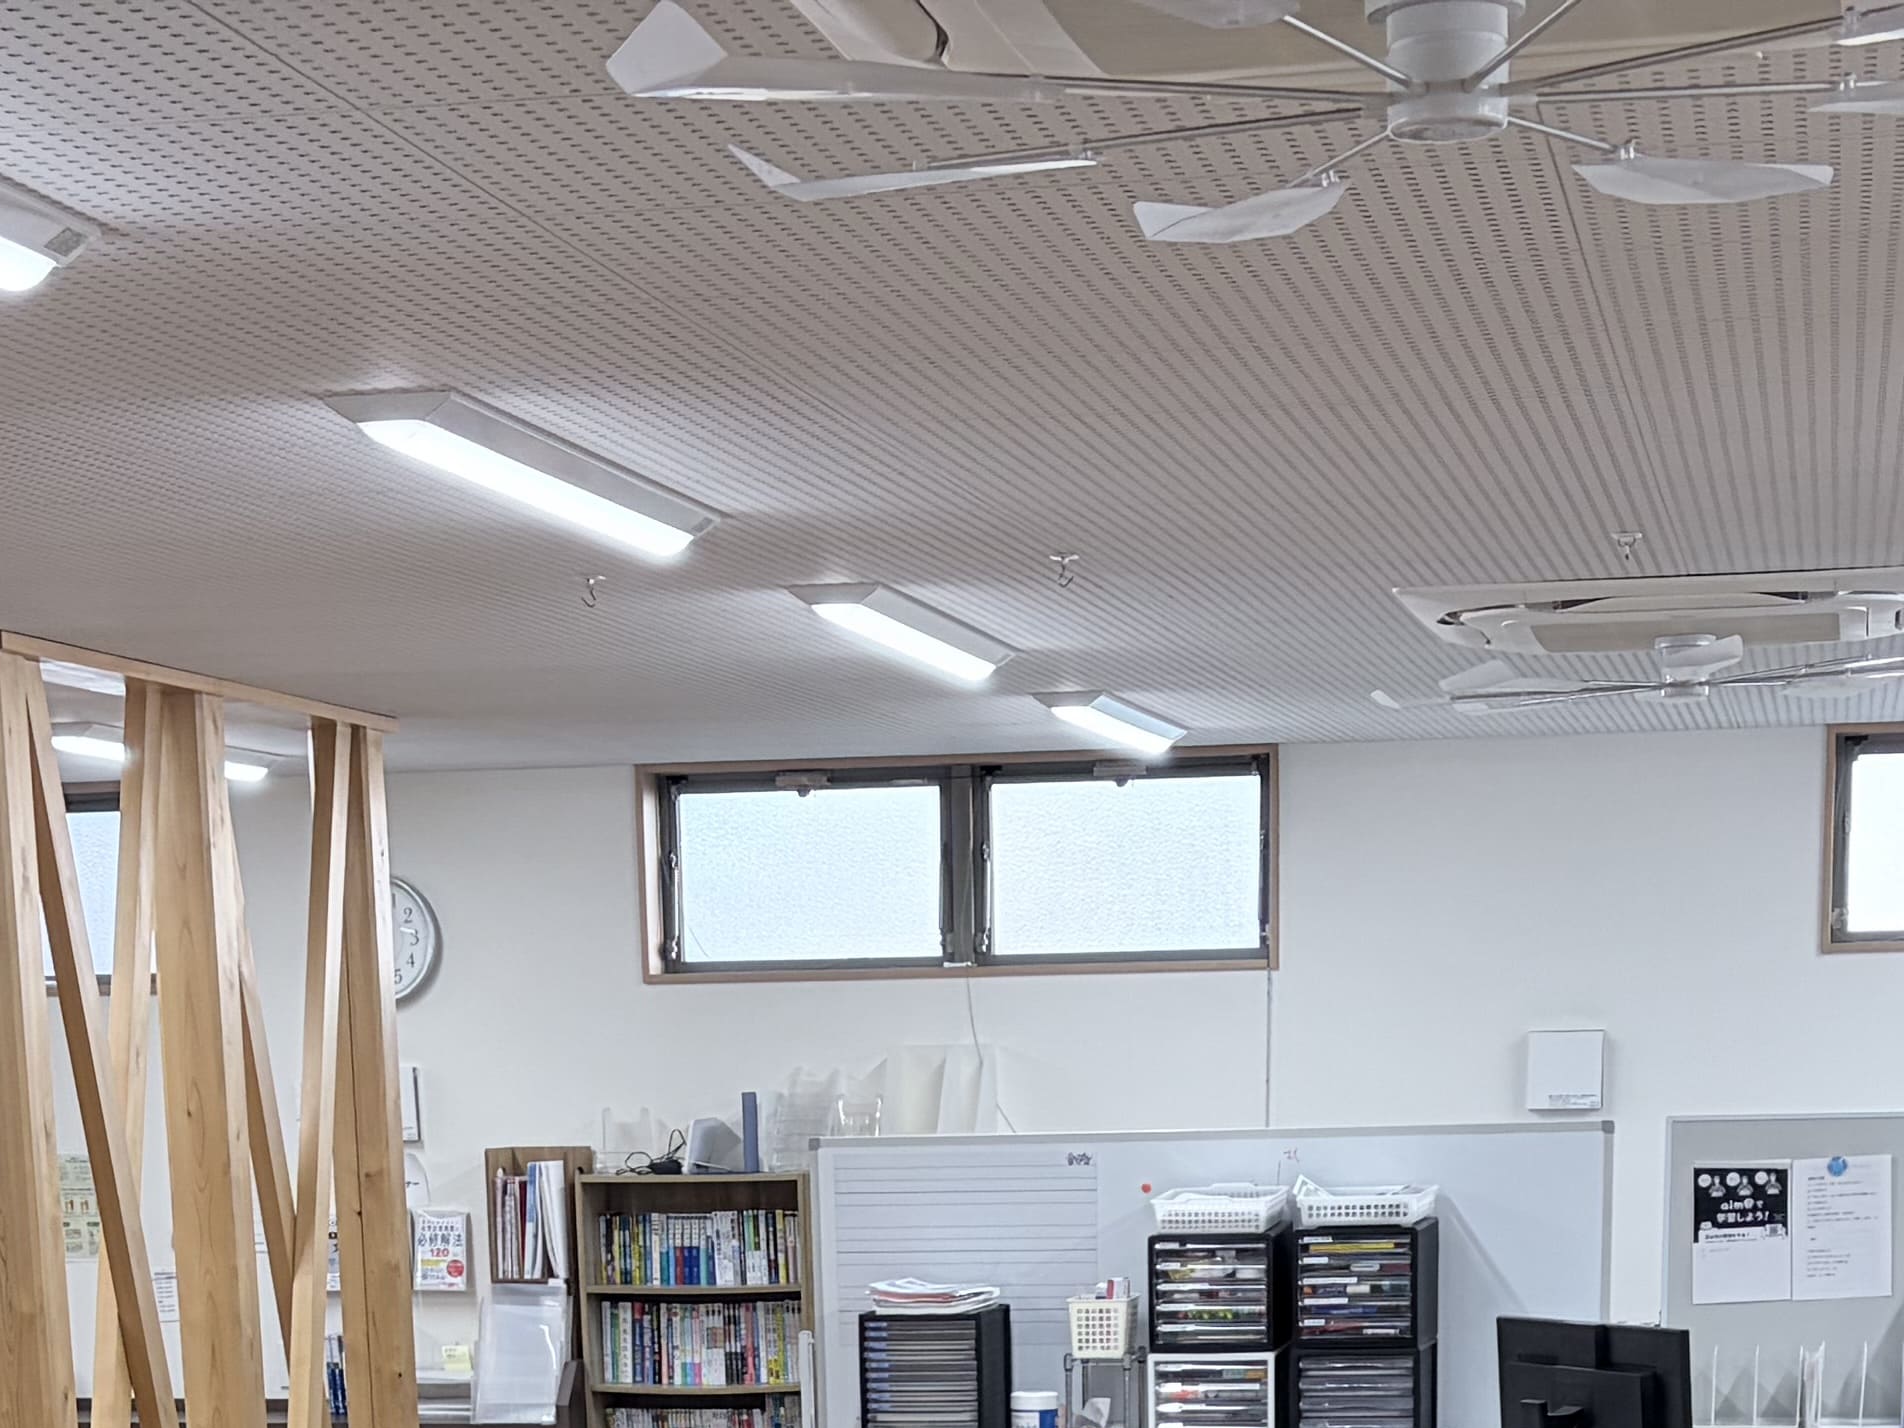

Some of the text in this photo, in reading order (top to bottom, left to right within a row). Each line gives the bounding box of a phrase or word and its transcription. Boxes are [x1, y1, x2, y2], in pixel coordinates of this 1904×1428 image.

[403, 907, 413, 923] 2
[410, 929, 420, 946] 3
[406, 952, 415, 968] 4
[394, 968, 402, 984] 5
[430, 1248, 449, 1257] 120
